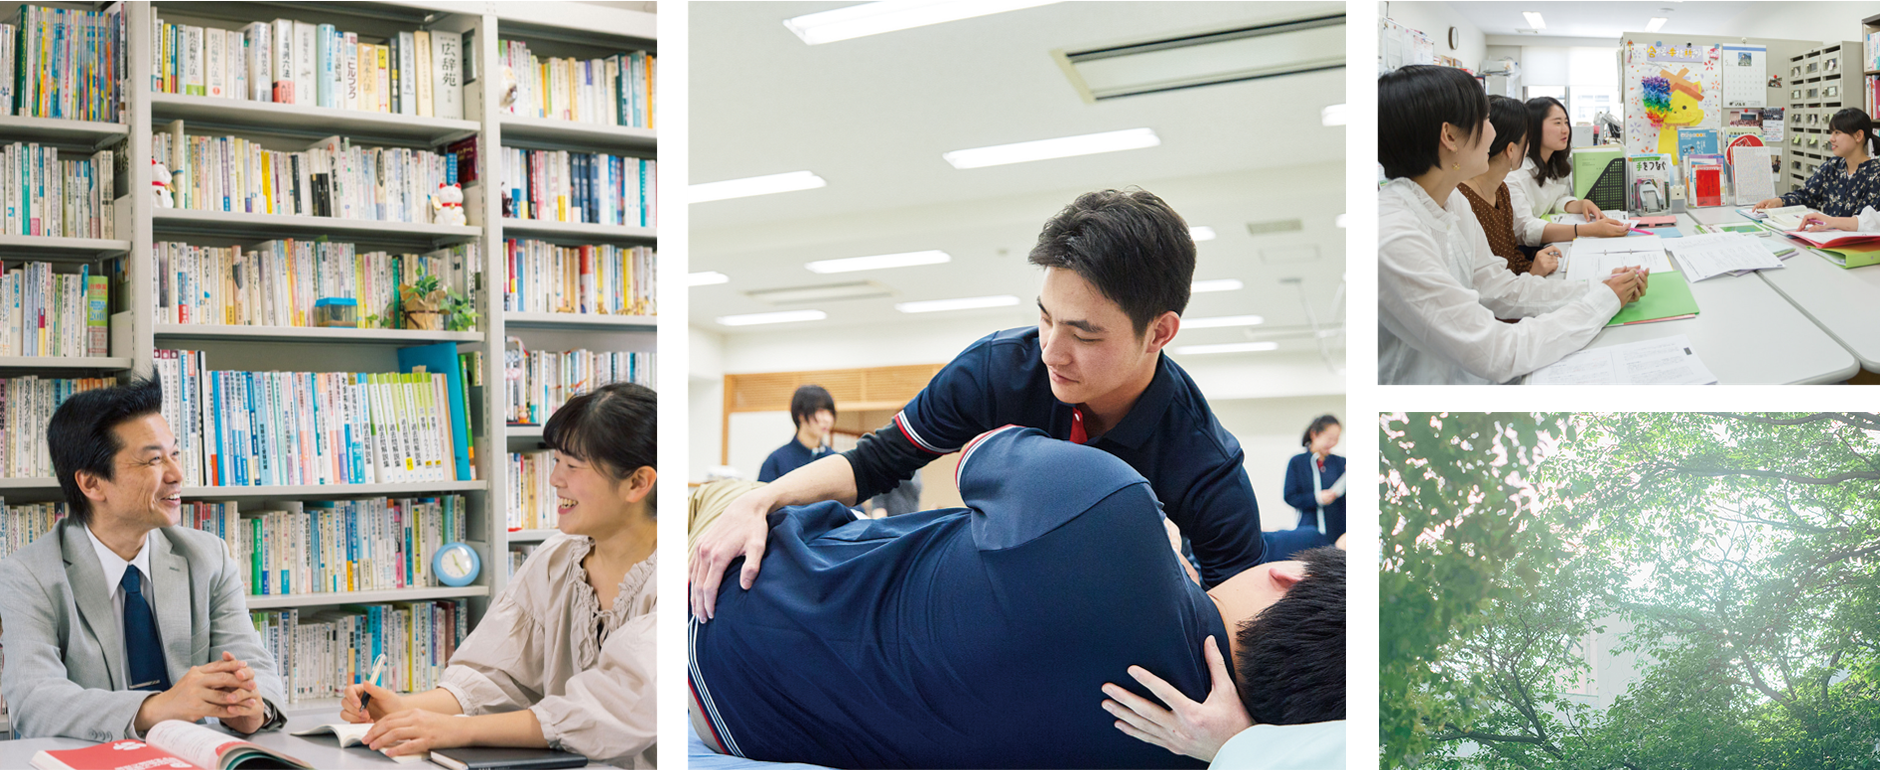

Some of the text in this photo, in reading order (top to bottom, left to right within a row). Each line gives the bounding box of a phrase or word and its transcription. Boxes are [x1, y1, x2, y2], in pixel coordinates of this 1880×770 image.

[189, 31, 197, 76] 社会福祉六法
[211, 33, 219, 78] 社会福祉六法
[441, 42, 457, 87] 広辞苑
[1636, 161, 1666, 172] 手をつなぐ
[89, 312, 107, 321] 2010
[363, 422, 372, 465] 過去問解説集
[378, 424, 390, 468] 過去問解説集
[389, 423, 401, 467] 過去問解説集
[401, 418, 411, 458] 過去問解説集
[411, 423, 422, 467] 過去問解説集
[420, 416, 430, 459] 受験ワークブック
[431, 416, 440, 459] 受験ワークブック
